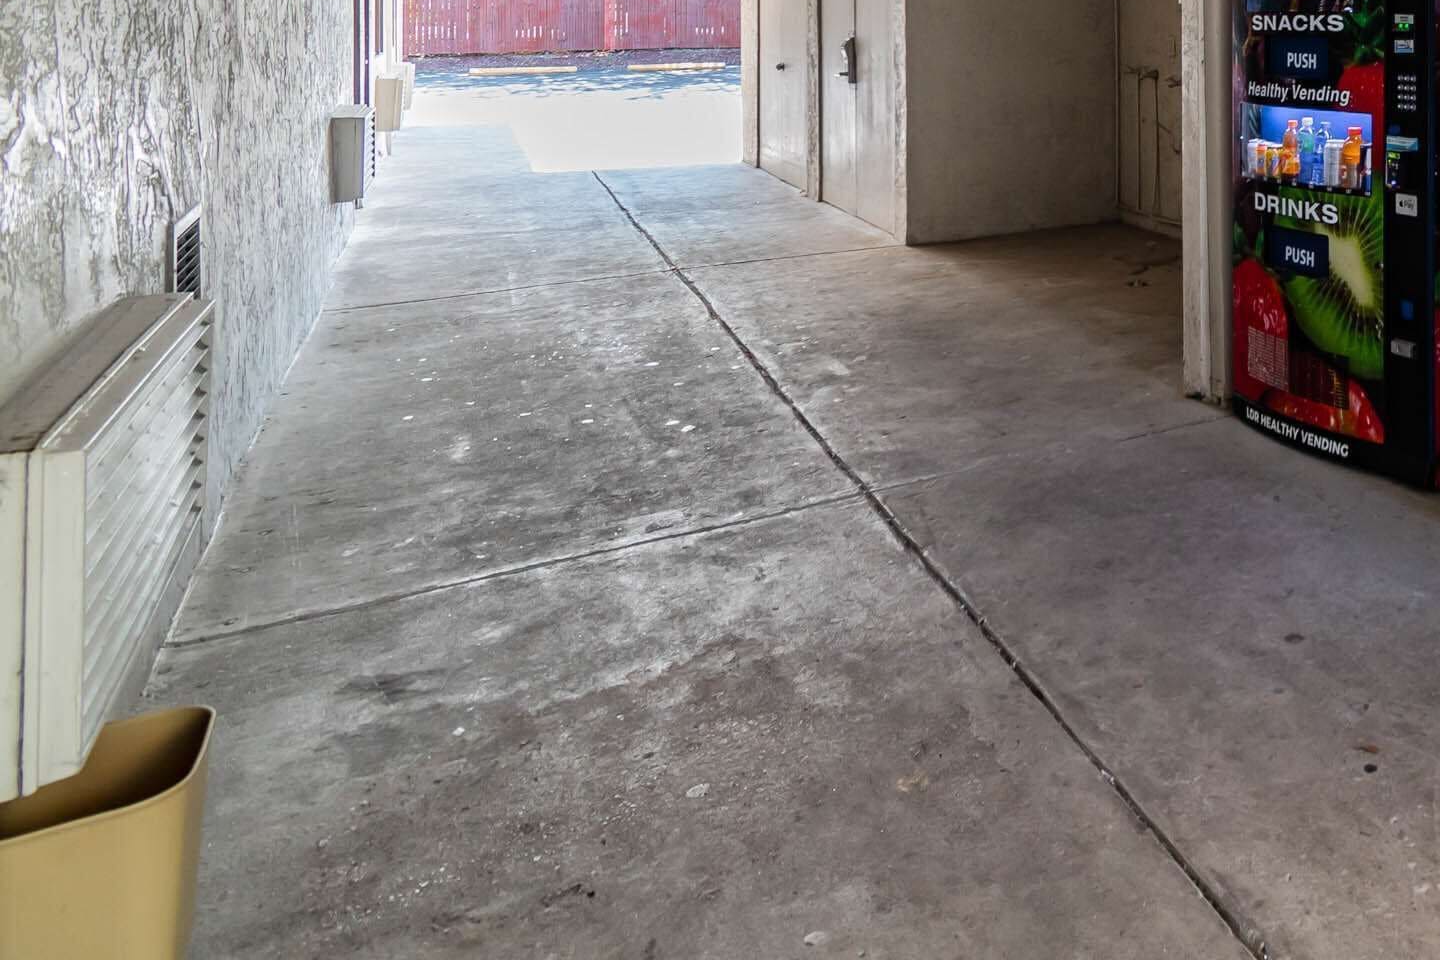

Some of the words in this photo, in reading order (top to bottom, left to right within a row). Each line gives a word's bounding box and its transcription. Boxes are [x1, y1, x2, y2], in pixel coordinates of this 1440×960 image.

[1252, 14, 1344, 32] SNACKS
[1287, 52, 1317, 70] PUSH
[1248, 81, 1289, 103] Healthy
[1292, 84, 1350, 107] Vending
[1254, 191, 1339, 224] DRINKS
[1285, 245, 1315, 268] PUSH
[1260, 413, 1300, 440] HEALTHY
[1301, 429, 1349, 457] VENDING
